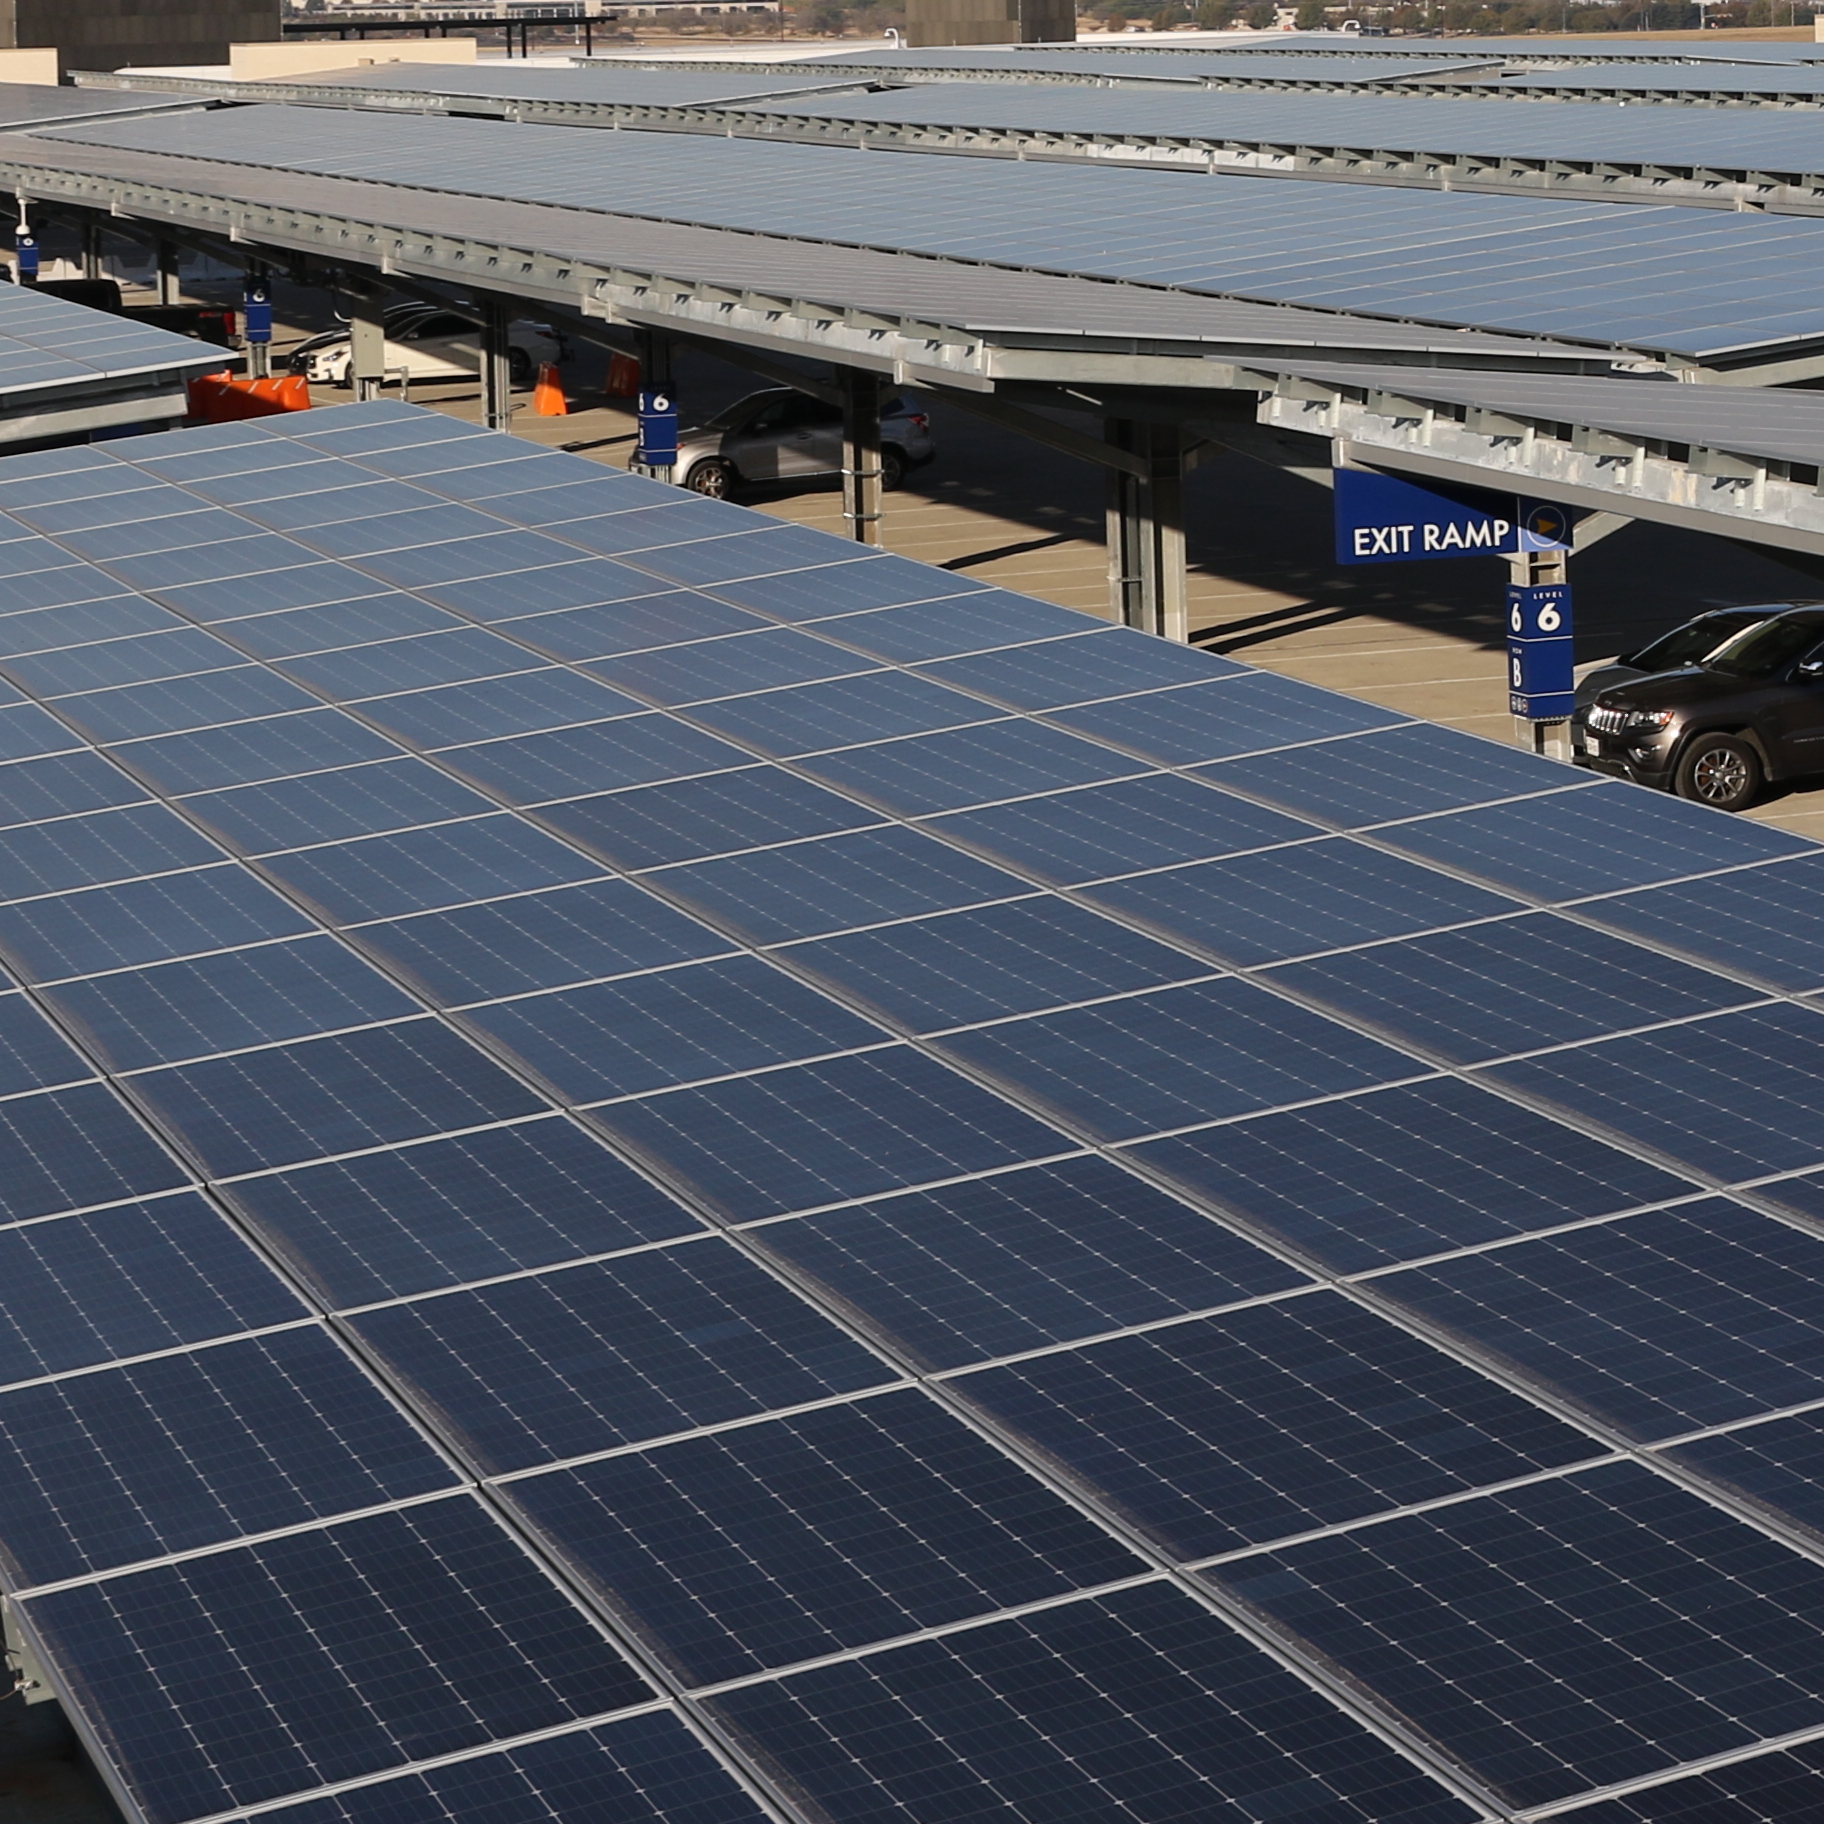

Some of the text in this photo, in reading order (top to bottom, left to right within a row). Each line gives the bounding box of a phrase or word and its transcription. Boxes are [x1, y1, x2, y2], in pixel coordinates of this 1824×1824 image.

[252, 288, 265, 303] 6
[652, 393, 669, 412] 6
[1353, 519, 1510, 556] EXIT RAMP
[1533, 591, 1563, 600] LEVEL
[1511, 602, 1522, 633] 6
[1537, 602, 1561, 632] 6
[1512, 657, 1522, 687] B
